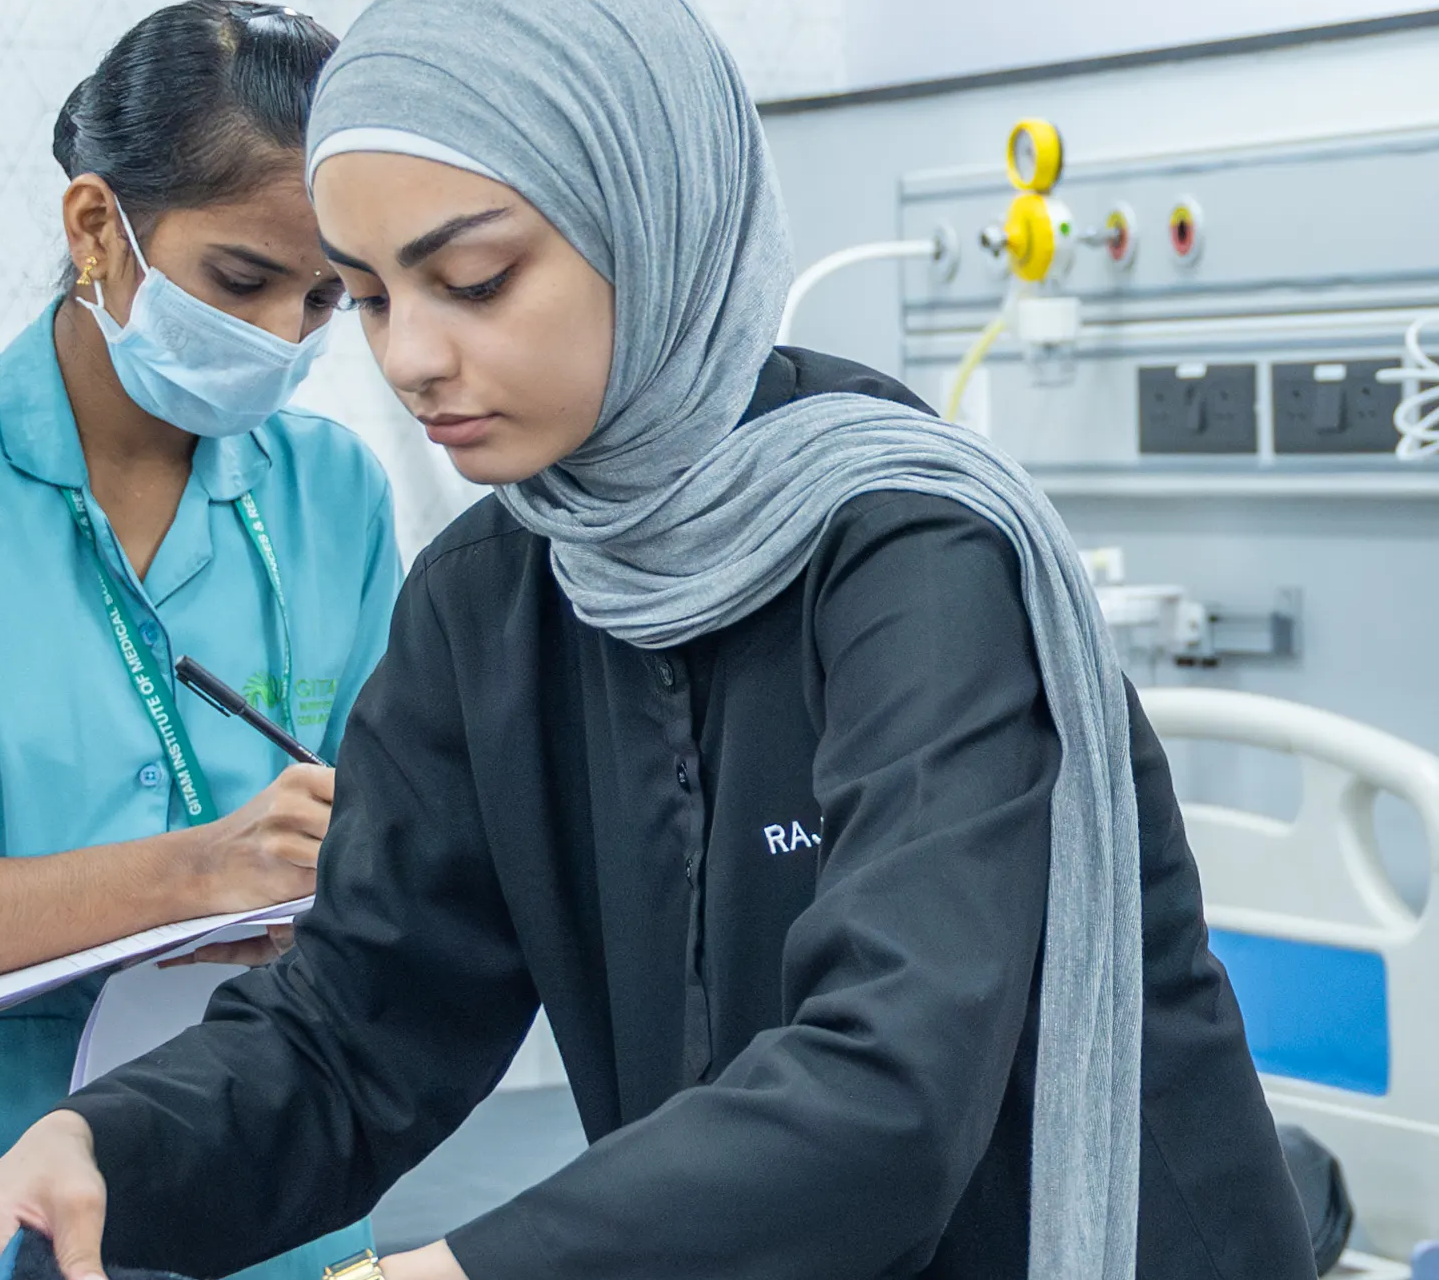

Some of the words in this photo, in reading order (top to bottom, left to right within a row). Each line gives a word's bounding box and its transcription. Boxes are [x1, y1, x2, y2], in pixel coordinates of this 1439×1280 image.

[110, 606, 145, 672] MEDICAL
[134, 673, 155, 696] OF
[145, 694, 188, 771] INSTITUTE
[176, 769, 203, 816] GITAM
